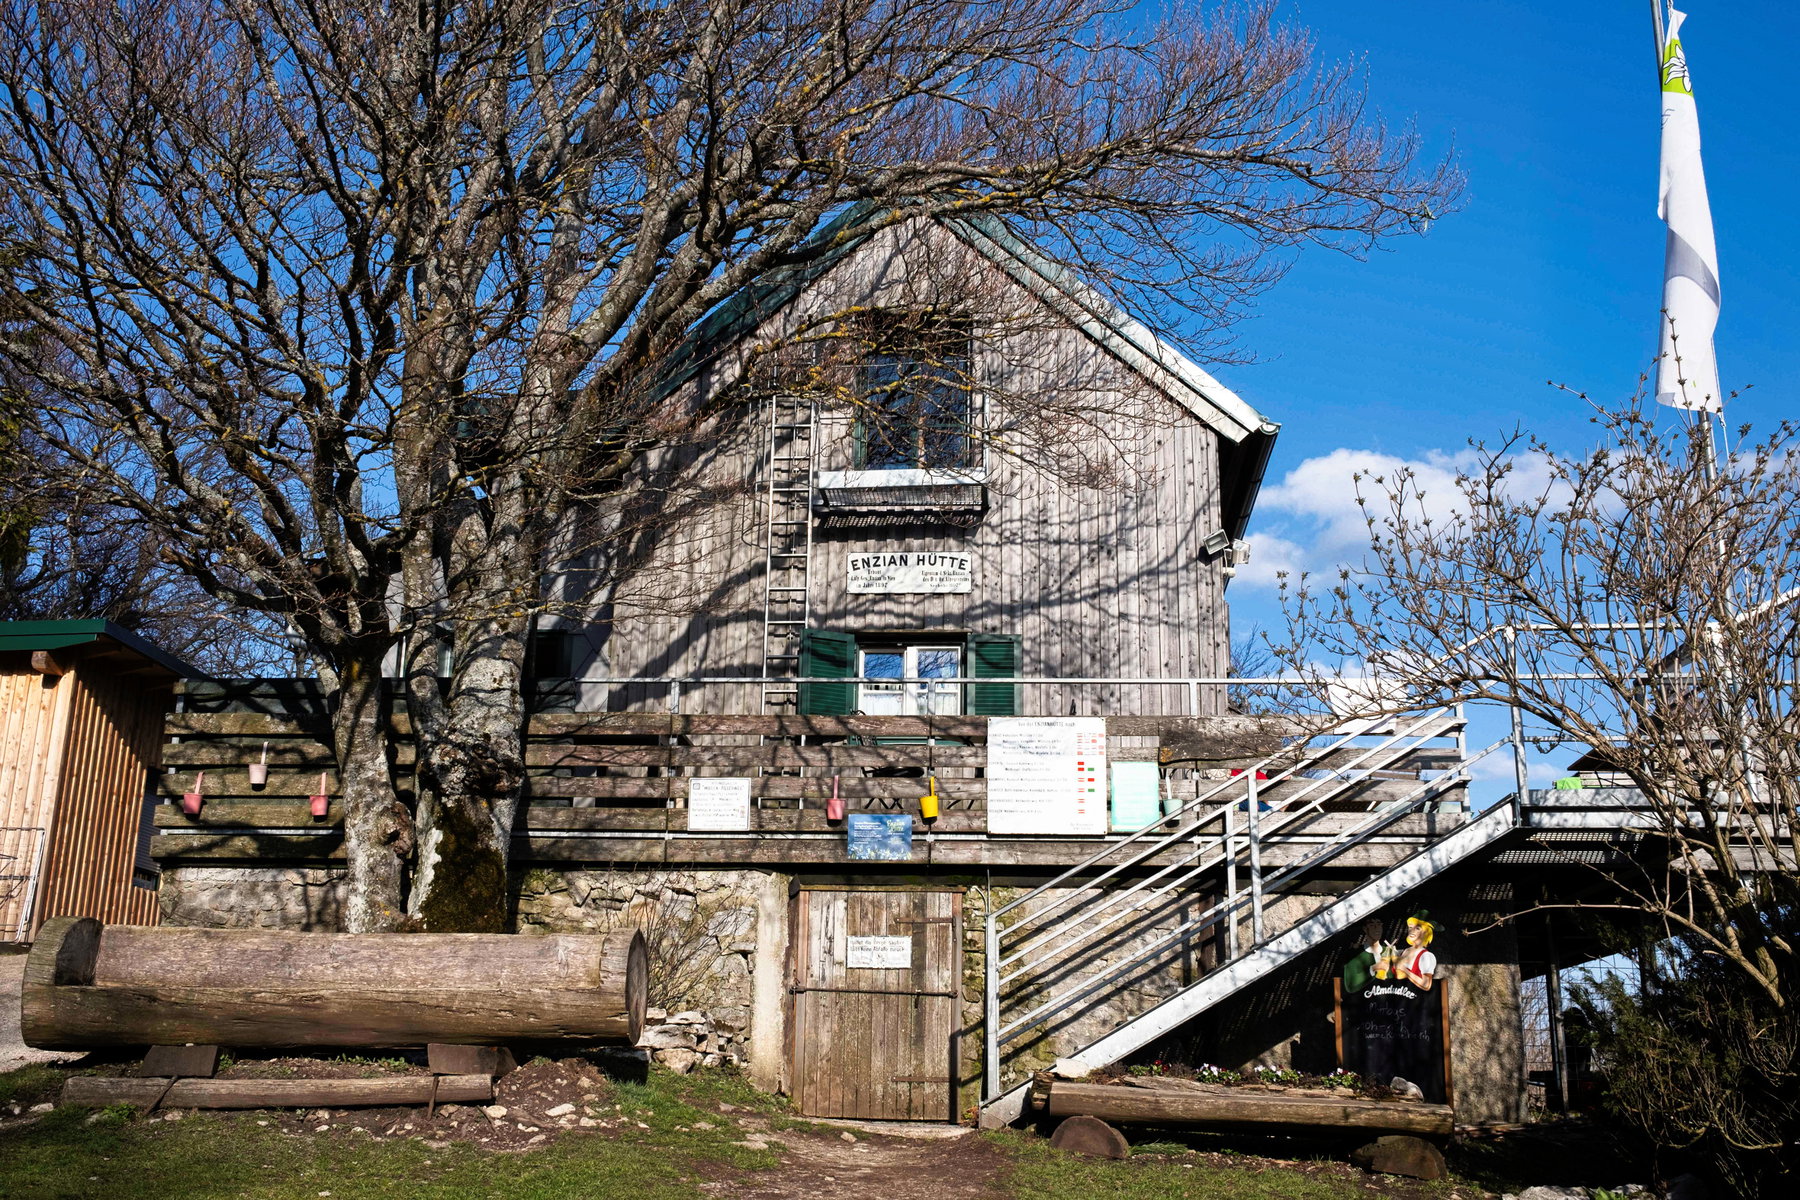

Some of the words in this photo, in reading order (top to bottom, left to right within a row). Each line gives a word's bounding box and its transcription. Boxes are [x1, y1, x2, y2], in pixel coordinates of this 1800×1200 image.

[851, 554, 908, 571] ENZIAN
[916, 553, 968, 570] HÜTTE
[1363, 984, 1418, 1000] Almdudler
